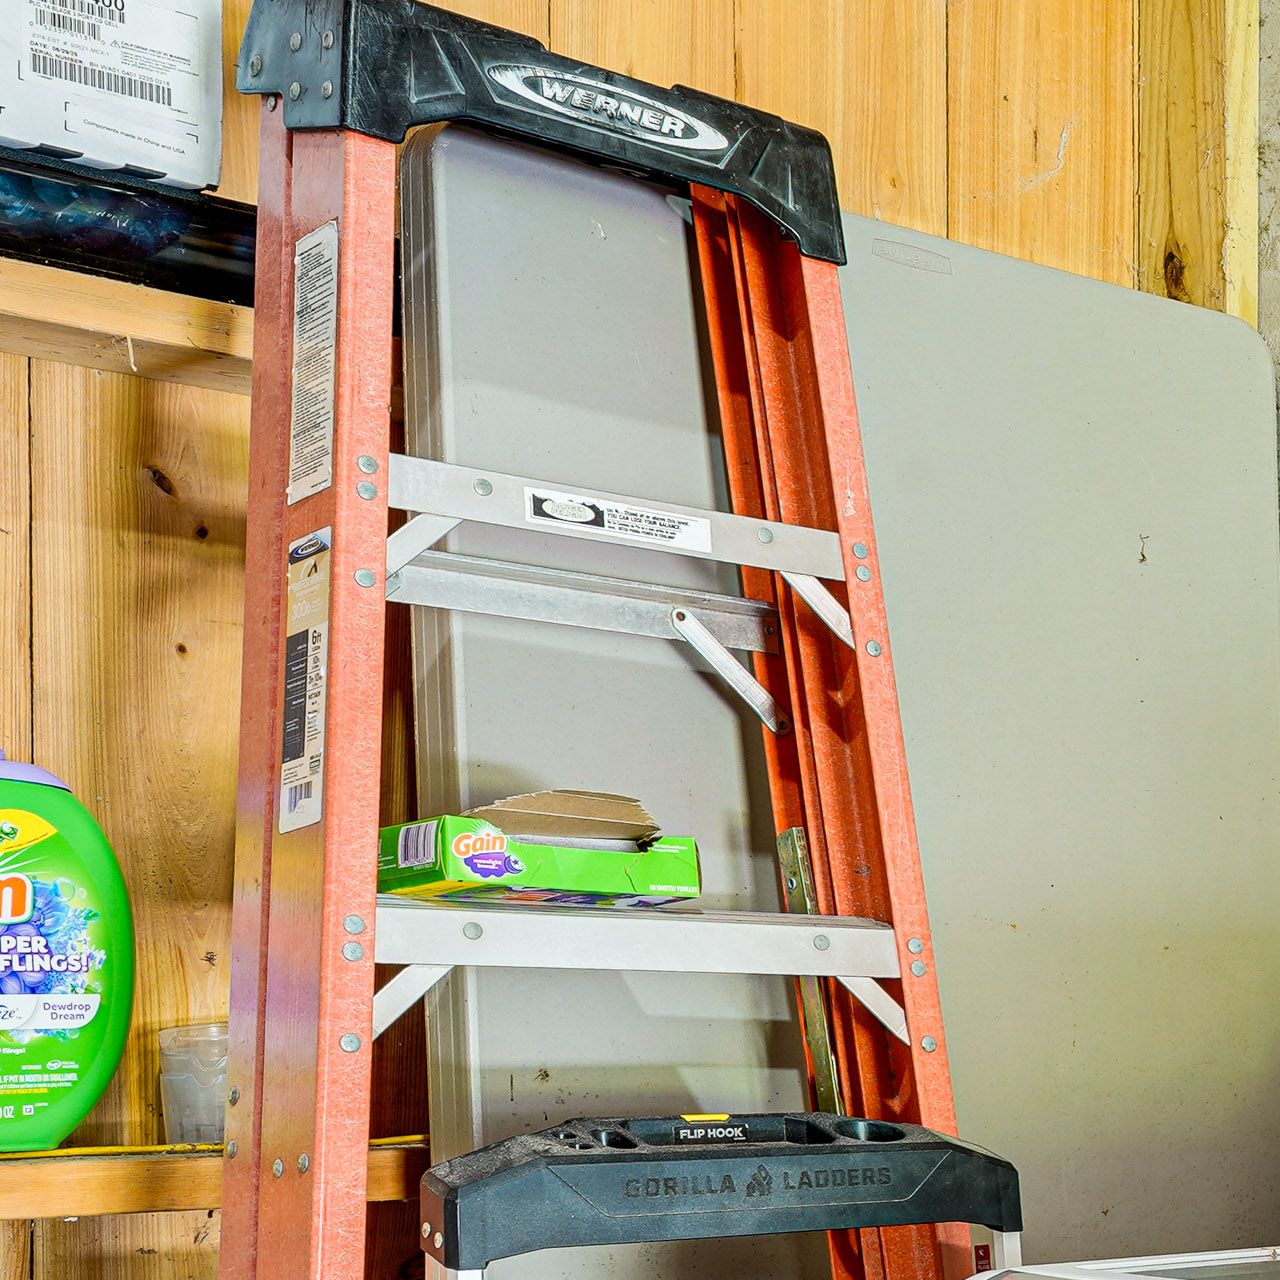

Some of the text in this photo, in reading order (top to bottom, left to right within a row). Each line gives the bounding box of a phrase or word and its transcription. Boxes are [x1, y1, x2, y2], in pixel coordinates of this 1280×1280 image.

[30, 47, 53, 57] SERIAL
[540, 77, 687, 139] WERNER
[83, 118, 119, 134] Components
[120, 131, 136, 140] made
[143, 137, 160, 148] China
[160, 143, 172, 151] and
[172, 146, 186, 155] USA
[454, 832, 505, 857] Gain
[0, 954, 90, 972] FLINGS!
[43, 1002, 92, 1013] Dewdrop
[50, 1011, 85, 1020] Dream
[680, 1127, 744, 1140] FLIP HOOK
[623, 1167, 892, 1199] GORILLA LADDERS
